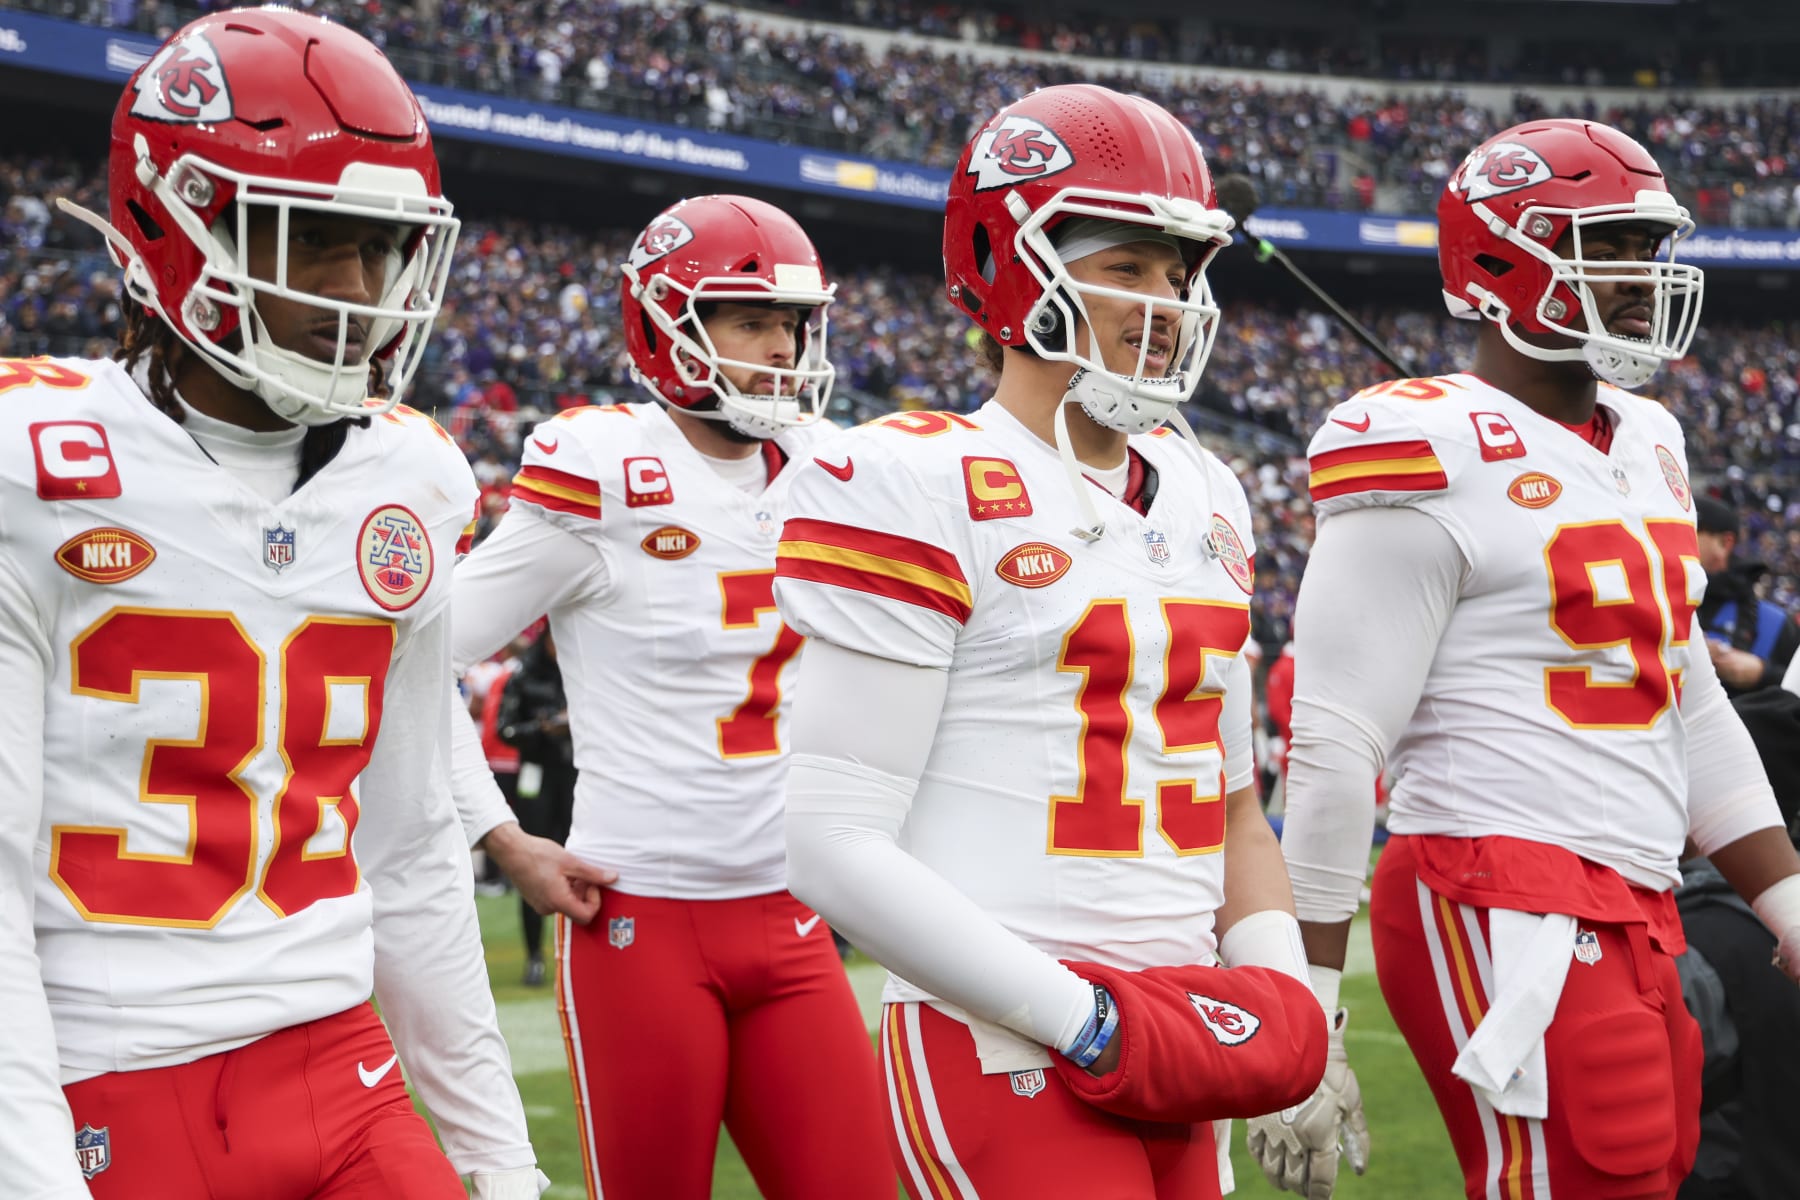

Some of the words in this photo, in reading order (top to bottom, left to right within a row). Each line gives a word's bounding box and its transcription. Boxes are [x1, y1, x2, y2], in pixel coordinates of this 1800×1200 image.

[492, 112, 571, 144] medical
[571, 122, 621, 152] team
[621, 129, 647, 155] of
[644, 132, 675, 161] the
[990, 129, 1057, 176] KC
[1477, 152, 1538, 187] KC
[1736, 239, 1785, 260] team
[1475, 412, 1518, 448] C
[38, 425, 111, 479] C
[628, 458, 669, 494] C
[968, 459, 1024, 501] C
[1519, 480, 1550, 500] NKH
[82, 541, 132, 569] NKH
[270, 544, 292, 564] NFL
[656, 535, 687, 551] NKH
[1150, 543, 1169, 559] NFL
[1016, 552, 1056, 577] NKH
[1046, 598, 1251, 858] 15
[48, 605, 398, 930] 38
[1199, 1003, 1246, 1036] KC
[1015, 1071, 1041, 1090] NFL
